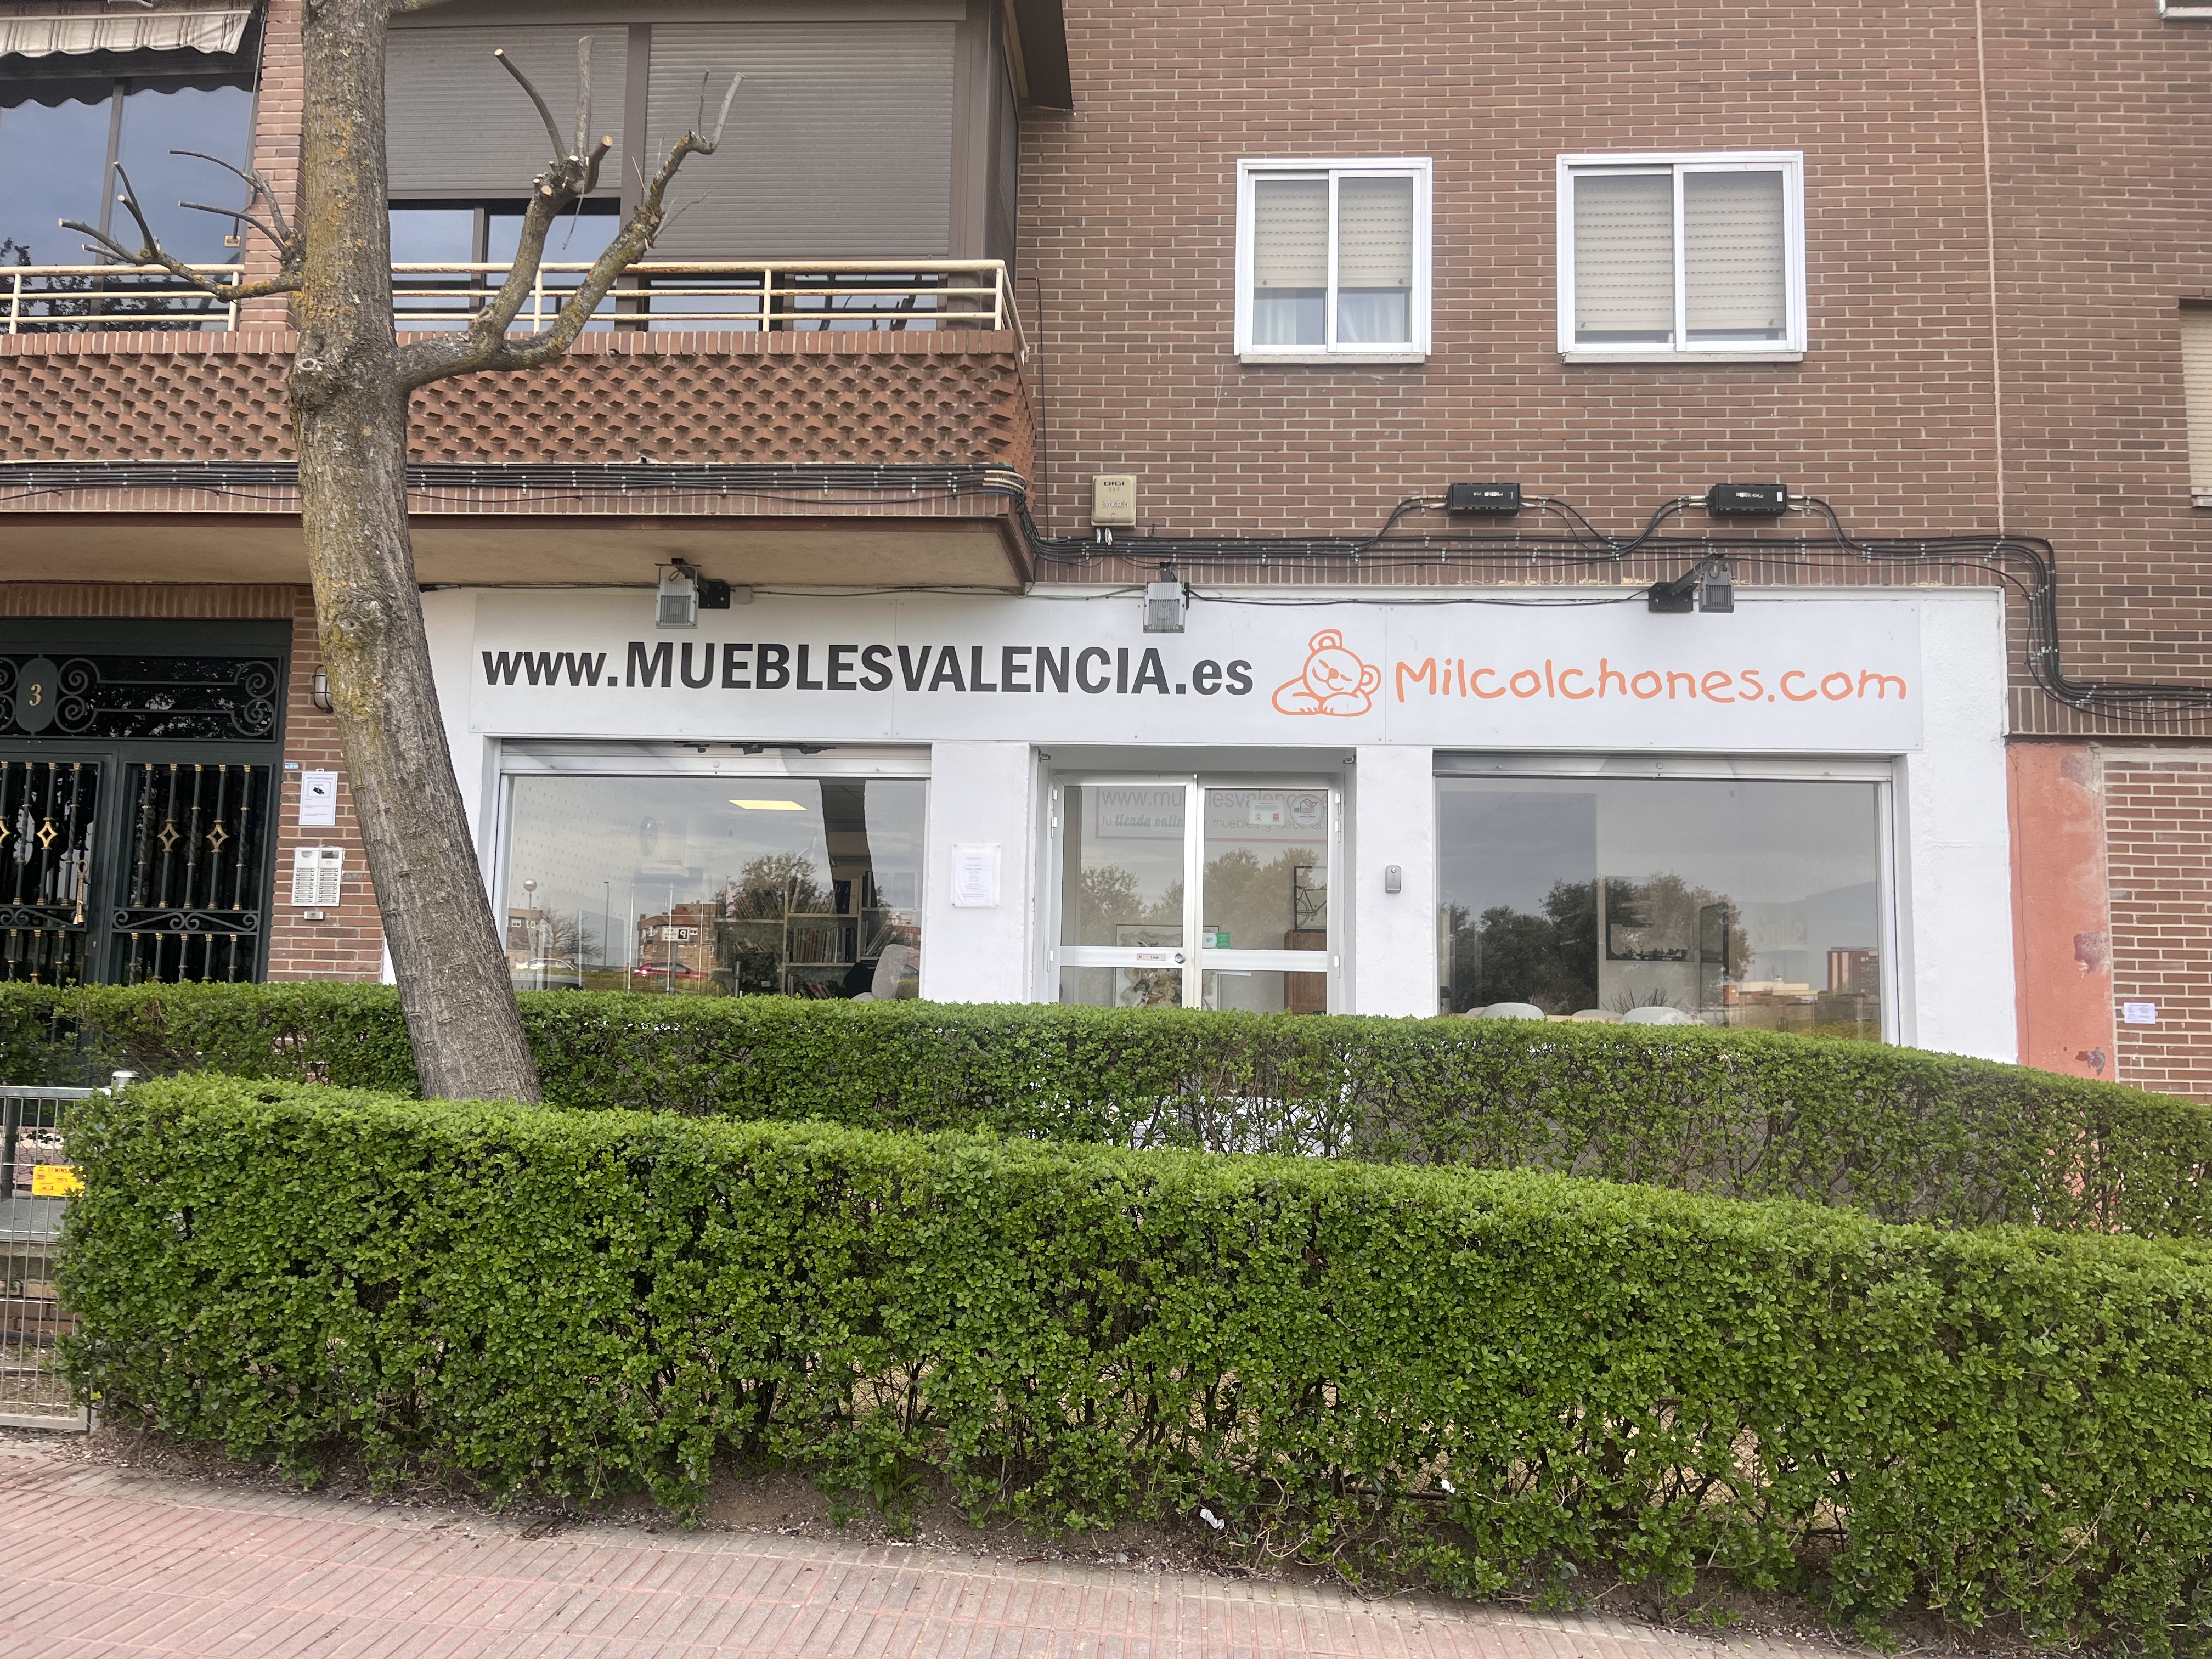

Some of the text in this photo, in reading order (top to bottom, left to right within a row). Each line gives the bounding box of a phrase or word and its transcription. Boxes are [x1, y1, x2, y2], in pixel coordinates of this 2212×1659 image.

[482, 641, 1253, 696] www.MUEBLESVALENCIA.es
[1396, 658, 1906, 703] Milcolchones.com
[29, 684, 42, 706] 3
[1102, 816, 1112, 826] tu
[1115, 814, 1151, 827] tienda
[1154, 815, 1185, 828] onlin
